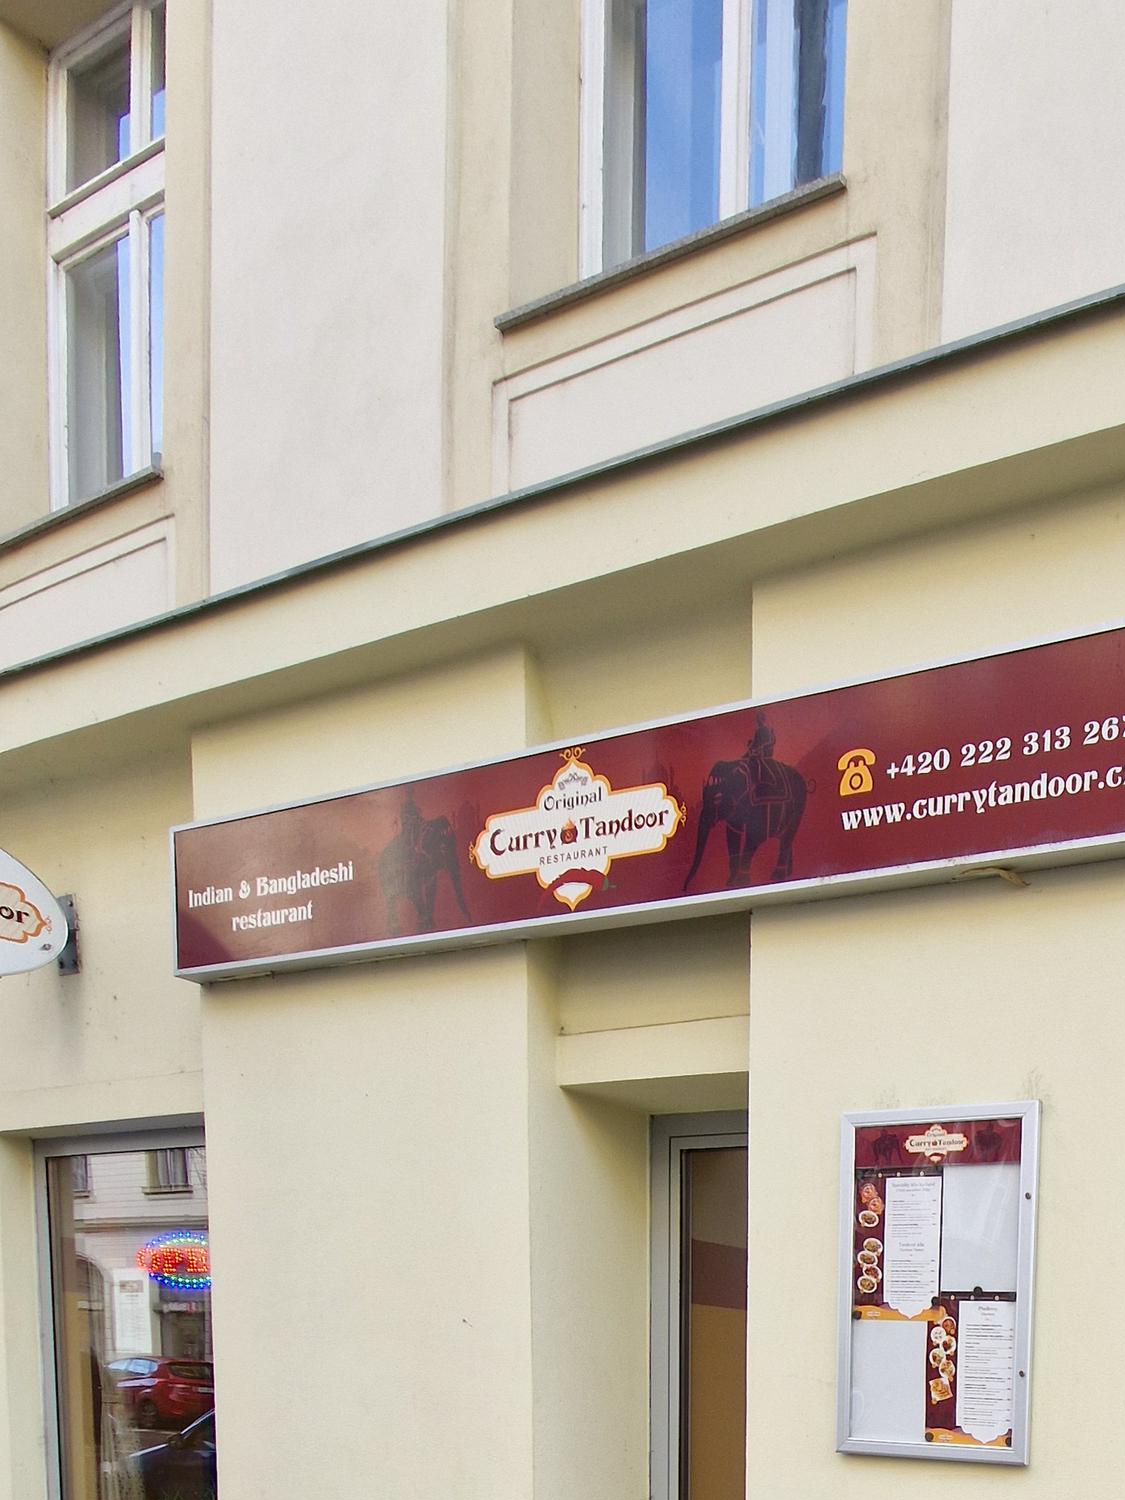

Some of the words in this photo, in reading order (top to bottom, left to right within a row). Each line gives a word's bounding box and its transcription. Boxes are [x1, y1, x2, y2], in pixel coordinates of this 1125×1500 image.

[886, 748, 951, 779] +420
[960, 737, 1011, 767] 222
[1022, 726, 1071, 756] 313
[543, 787, 601, 811] Original
[489, 828, 557, 856] Curry
[579, 809, 669, 839] Tandoor
[539, 846, 608, 866] RESTAURANT
[188, 886, 233, 908] Indian
[239, 880, 251, 899] &
[255, 861, 354, 896] Bangladeshi
[232, 900, 313, 931] restaurant
